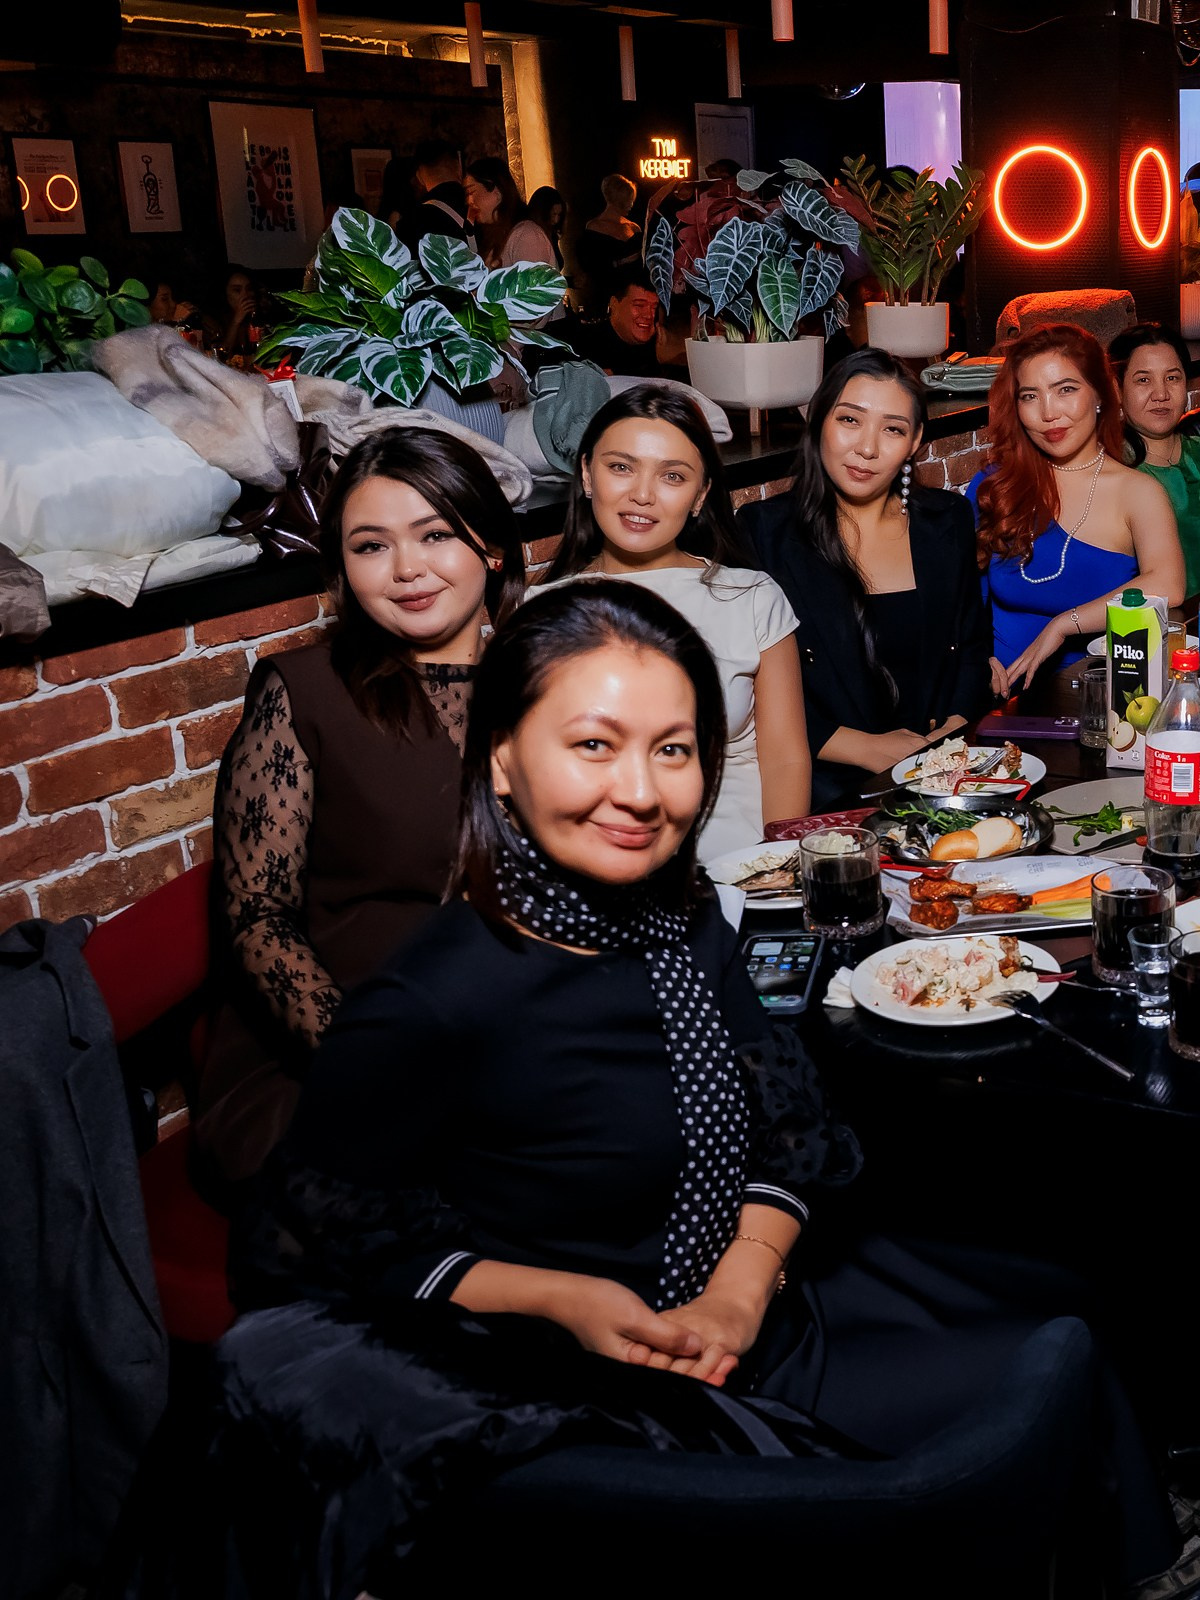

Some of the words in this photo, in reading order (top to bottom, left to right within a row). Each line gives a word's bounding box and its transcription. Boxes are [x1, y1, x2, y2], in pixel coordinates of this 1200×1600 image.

[651, 138, 677, 157] TYM
[640, 159, 691, 178] KEREMET
[1113, 644, 1144, 660] Piko
